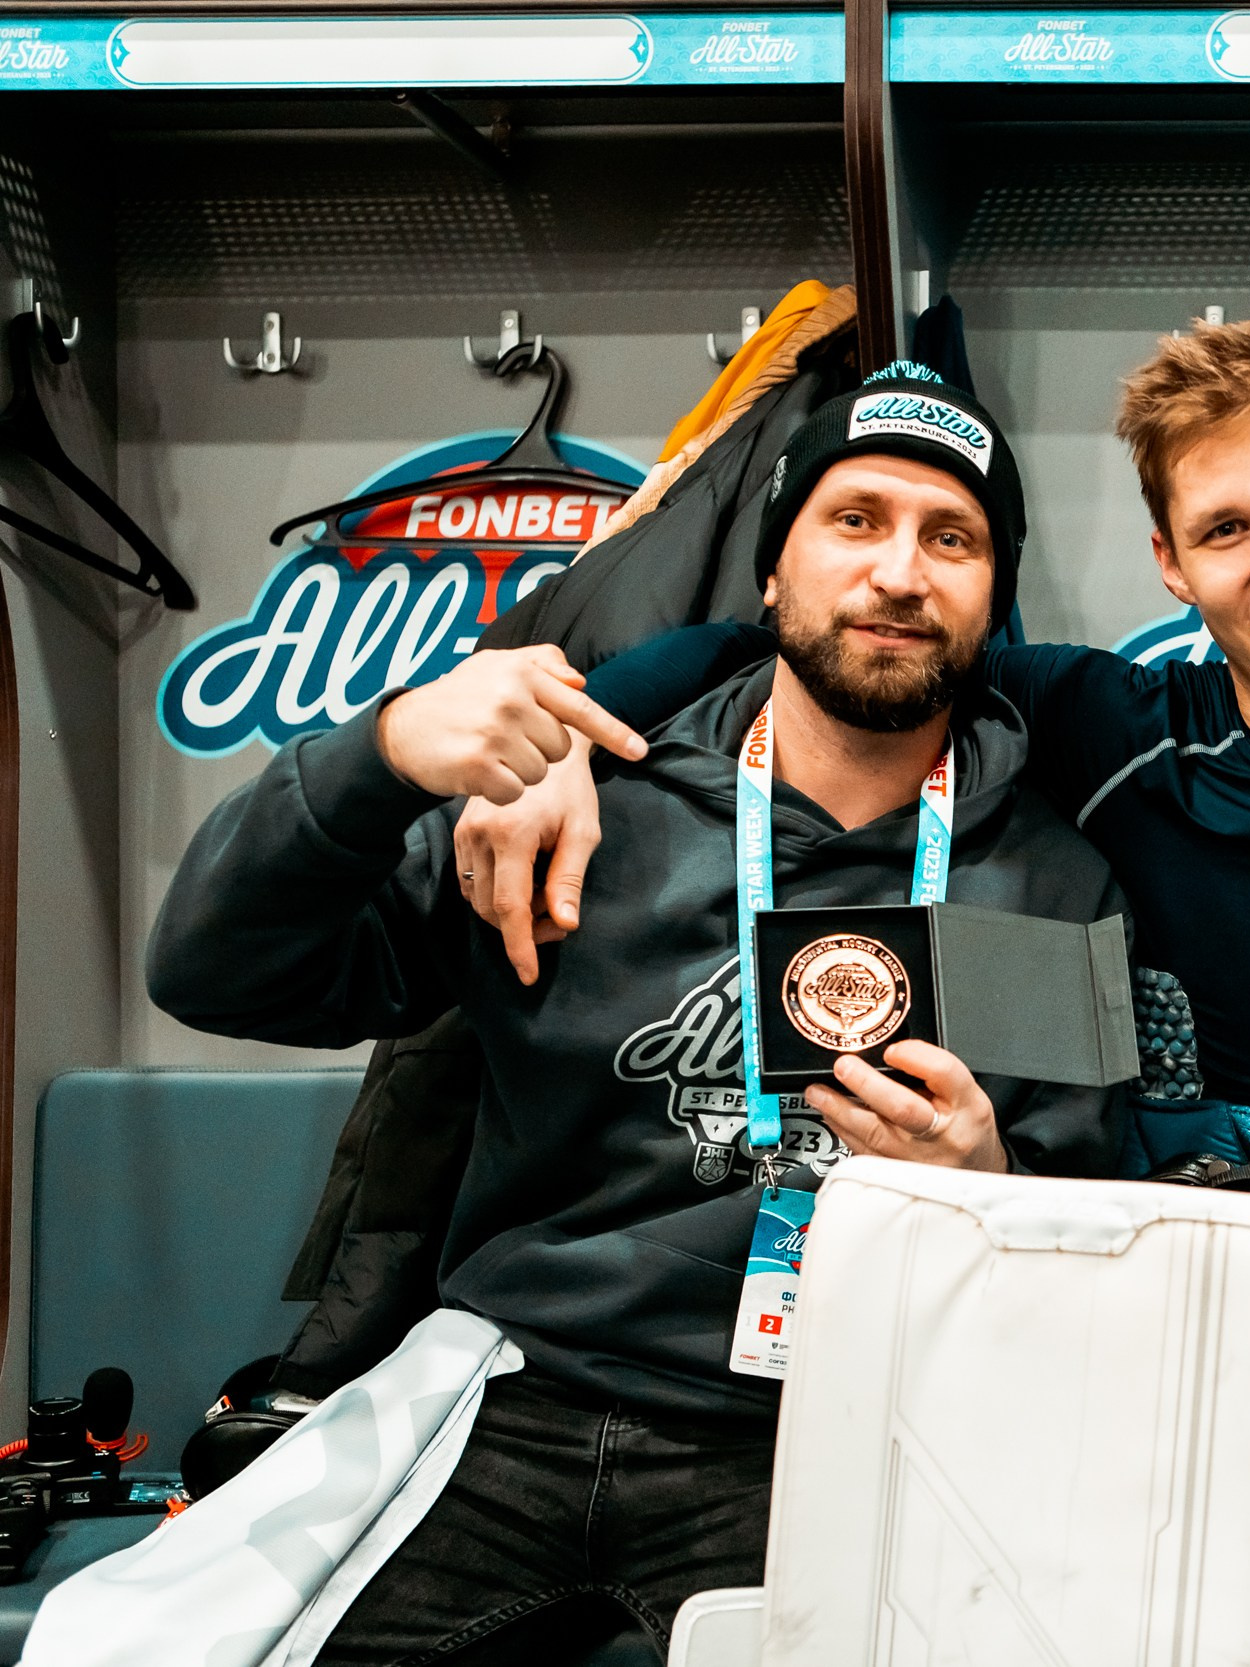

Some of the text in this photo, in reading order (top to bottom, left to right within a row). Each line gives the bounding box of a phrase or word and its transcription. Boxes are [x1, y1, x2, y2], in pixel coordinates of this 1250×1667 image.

[722, 22, 771, 33] FONBET
[1037, 20, 1087, 31] FONBET
[0, 40, 70, 70] l-Star
[690, 34, 799, 65] All-Star
[1004, 32, 1115, 61] All-Star
[856, 396, 988, 450] All-Star
[879, 423, 950, 442] PETERSBURG
[405, 495, 623, 539] FONBET
[746, 702, 769, 769] FONBE
[745, 805, 763, 860] WEEK
[922, 836, 942, 881] 2023
[746, 864, 765, 909] STAR
[690, 1091, 716, 1105] ST.
[702, 1146, 728, 1159] JHL
[765, 1318, 775, 1331] 2
